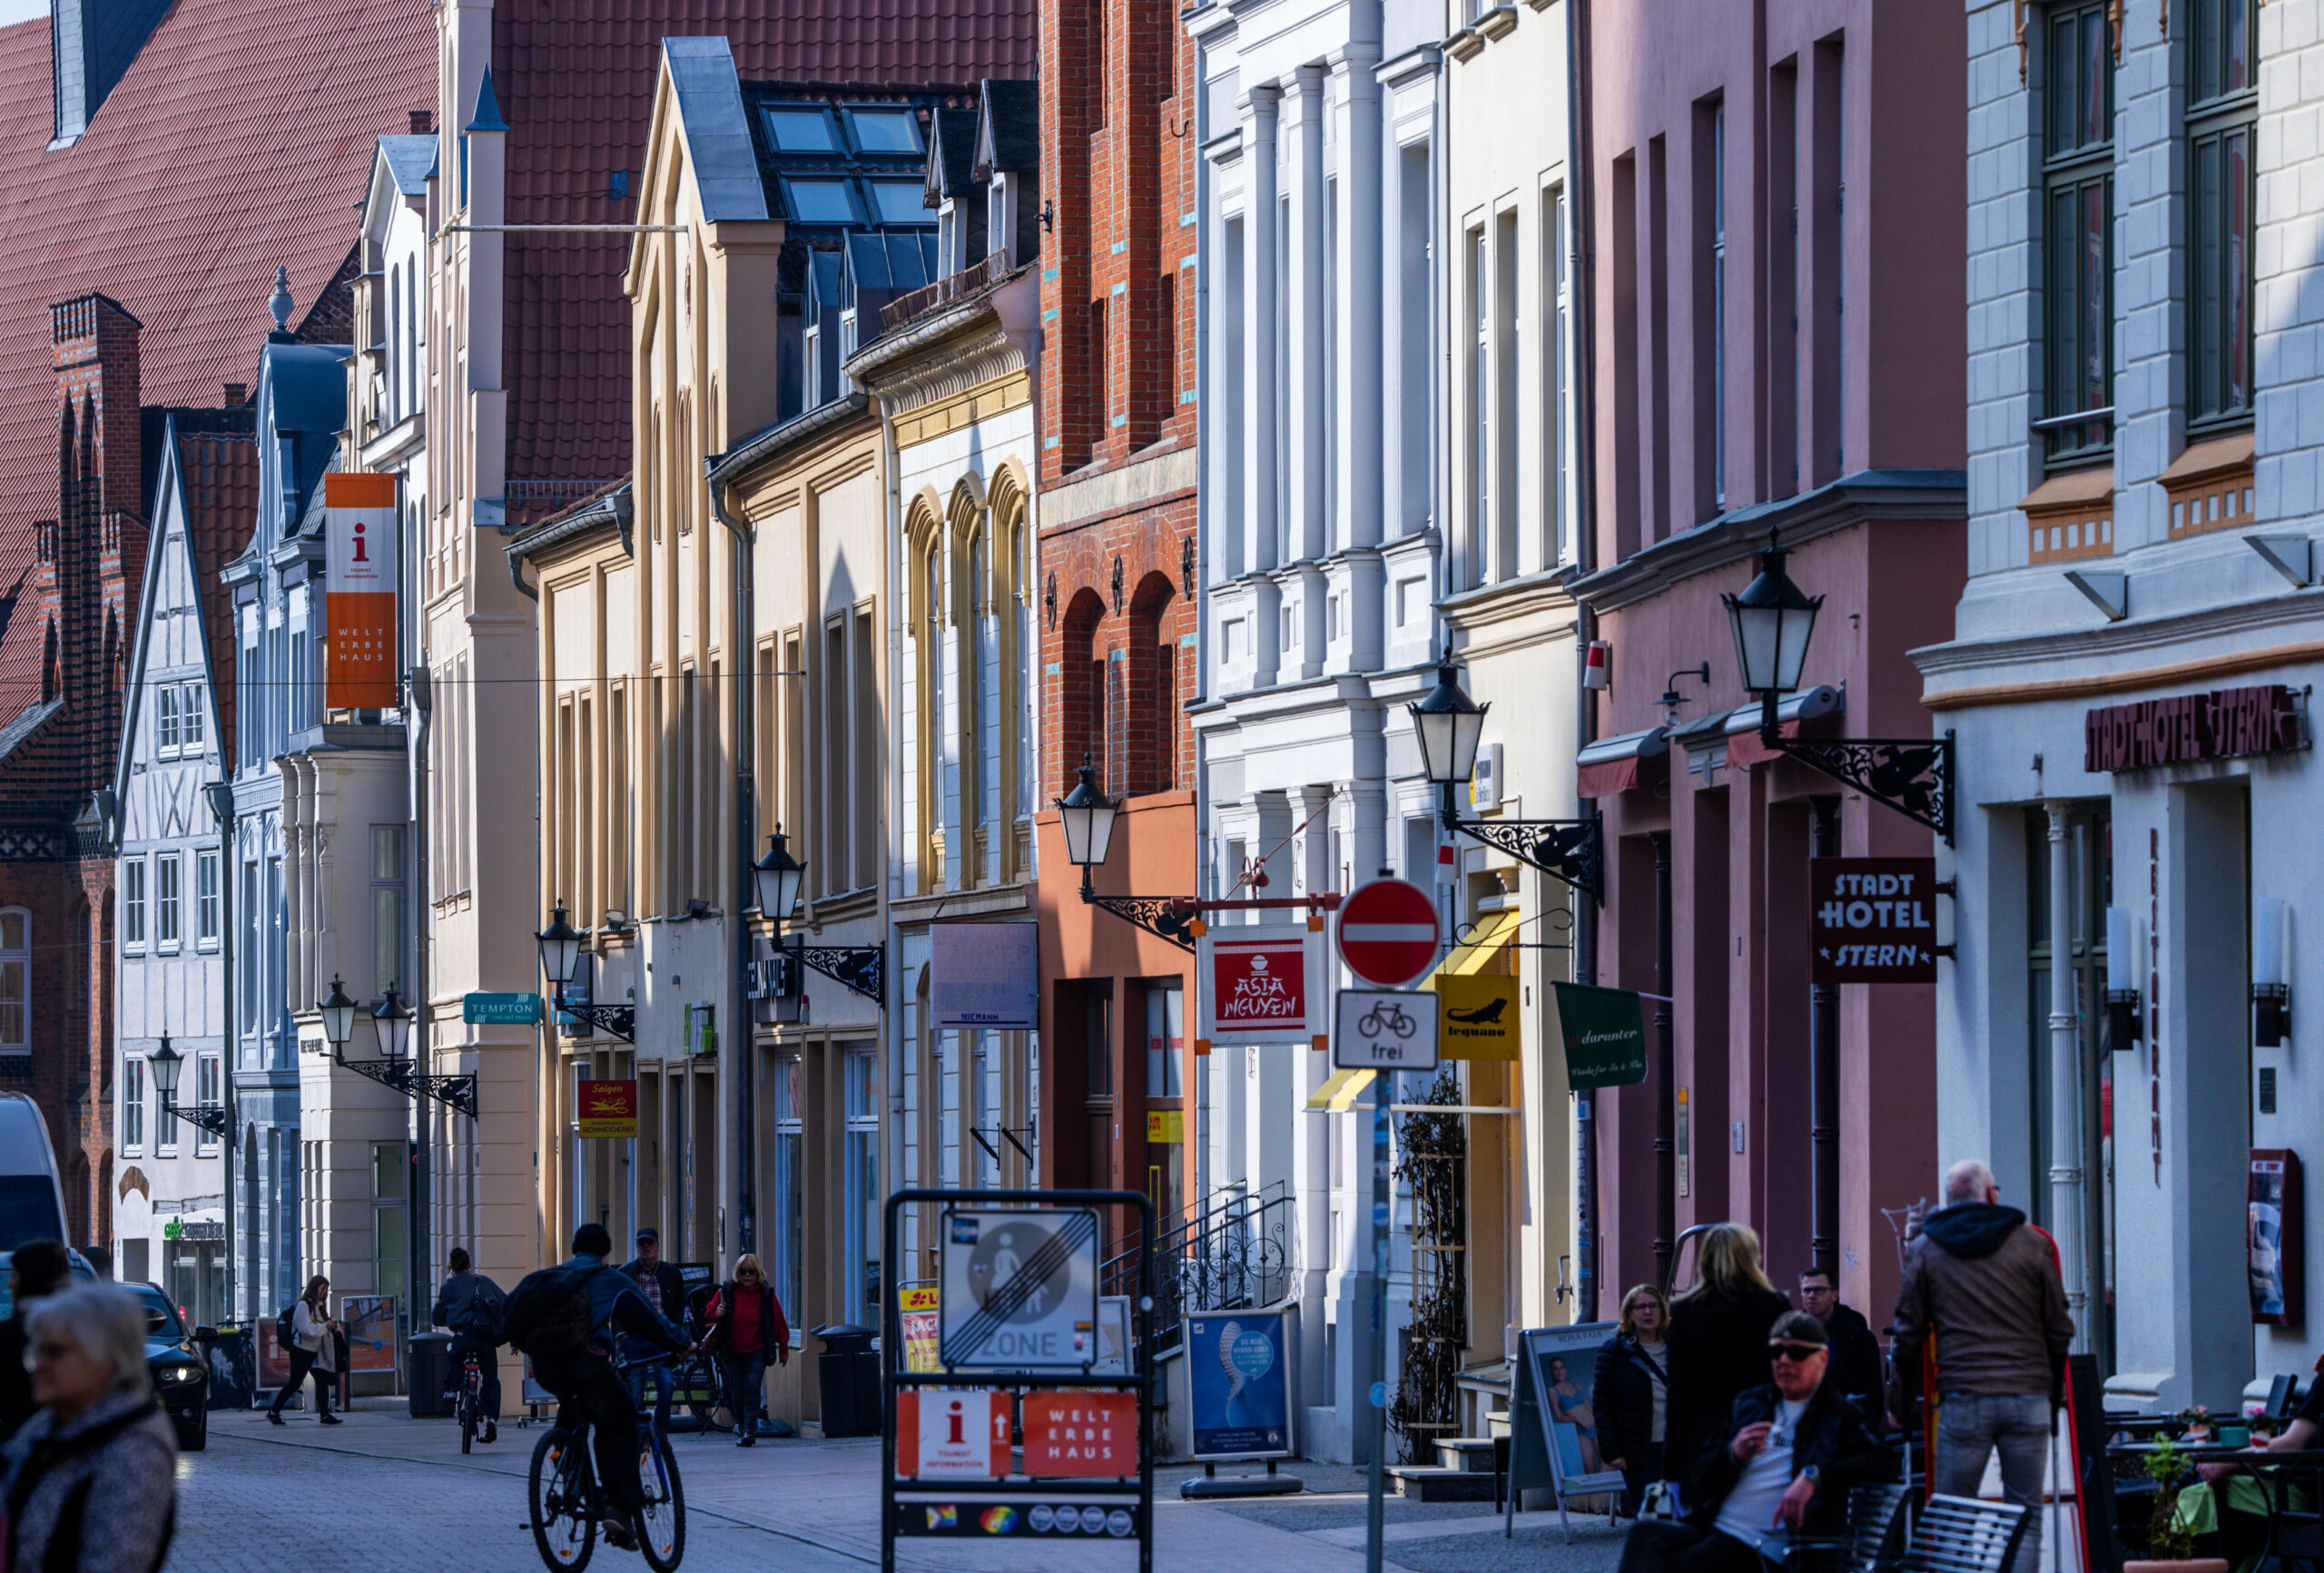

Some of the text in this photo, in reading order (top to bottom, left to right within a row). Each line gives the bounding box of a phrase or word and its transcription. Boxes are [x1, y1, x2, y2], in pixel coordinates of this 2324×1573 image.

[339, 628, 384, 636] WELT
[340, 641, 383, 649] ERBE
[1835, 874, 1915, 896] STADT
[1817, 900, 1930, 929] HOTEL
[1835, 944, 1917, 967] STERN
[1234, 977, 1285, 997] ASIA
[472, 1004, 532, 1013] TEMPTON
[1224, 997, 1296, 1017] NGUYEN
[960, 1013, 999, 1021] NIEMANN
[1581, 1029, 1638, 1045] darunter
[1372, 1042, 1403, 1060] frei
[592, 1084, 624, 1095] Saigon
[582, 1126, 634, 1134] SCHNEIDEREI
[1558, 1332, 1582, 1344] ROSA
[980, 1332, 1058, 1357] ZONE
[1049, 1410, 1112, 1422] WELT
[1049, 1429, 1112, 1441] ERBE
[1049, 1447, 1112, 1460] HAUS
